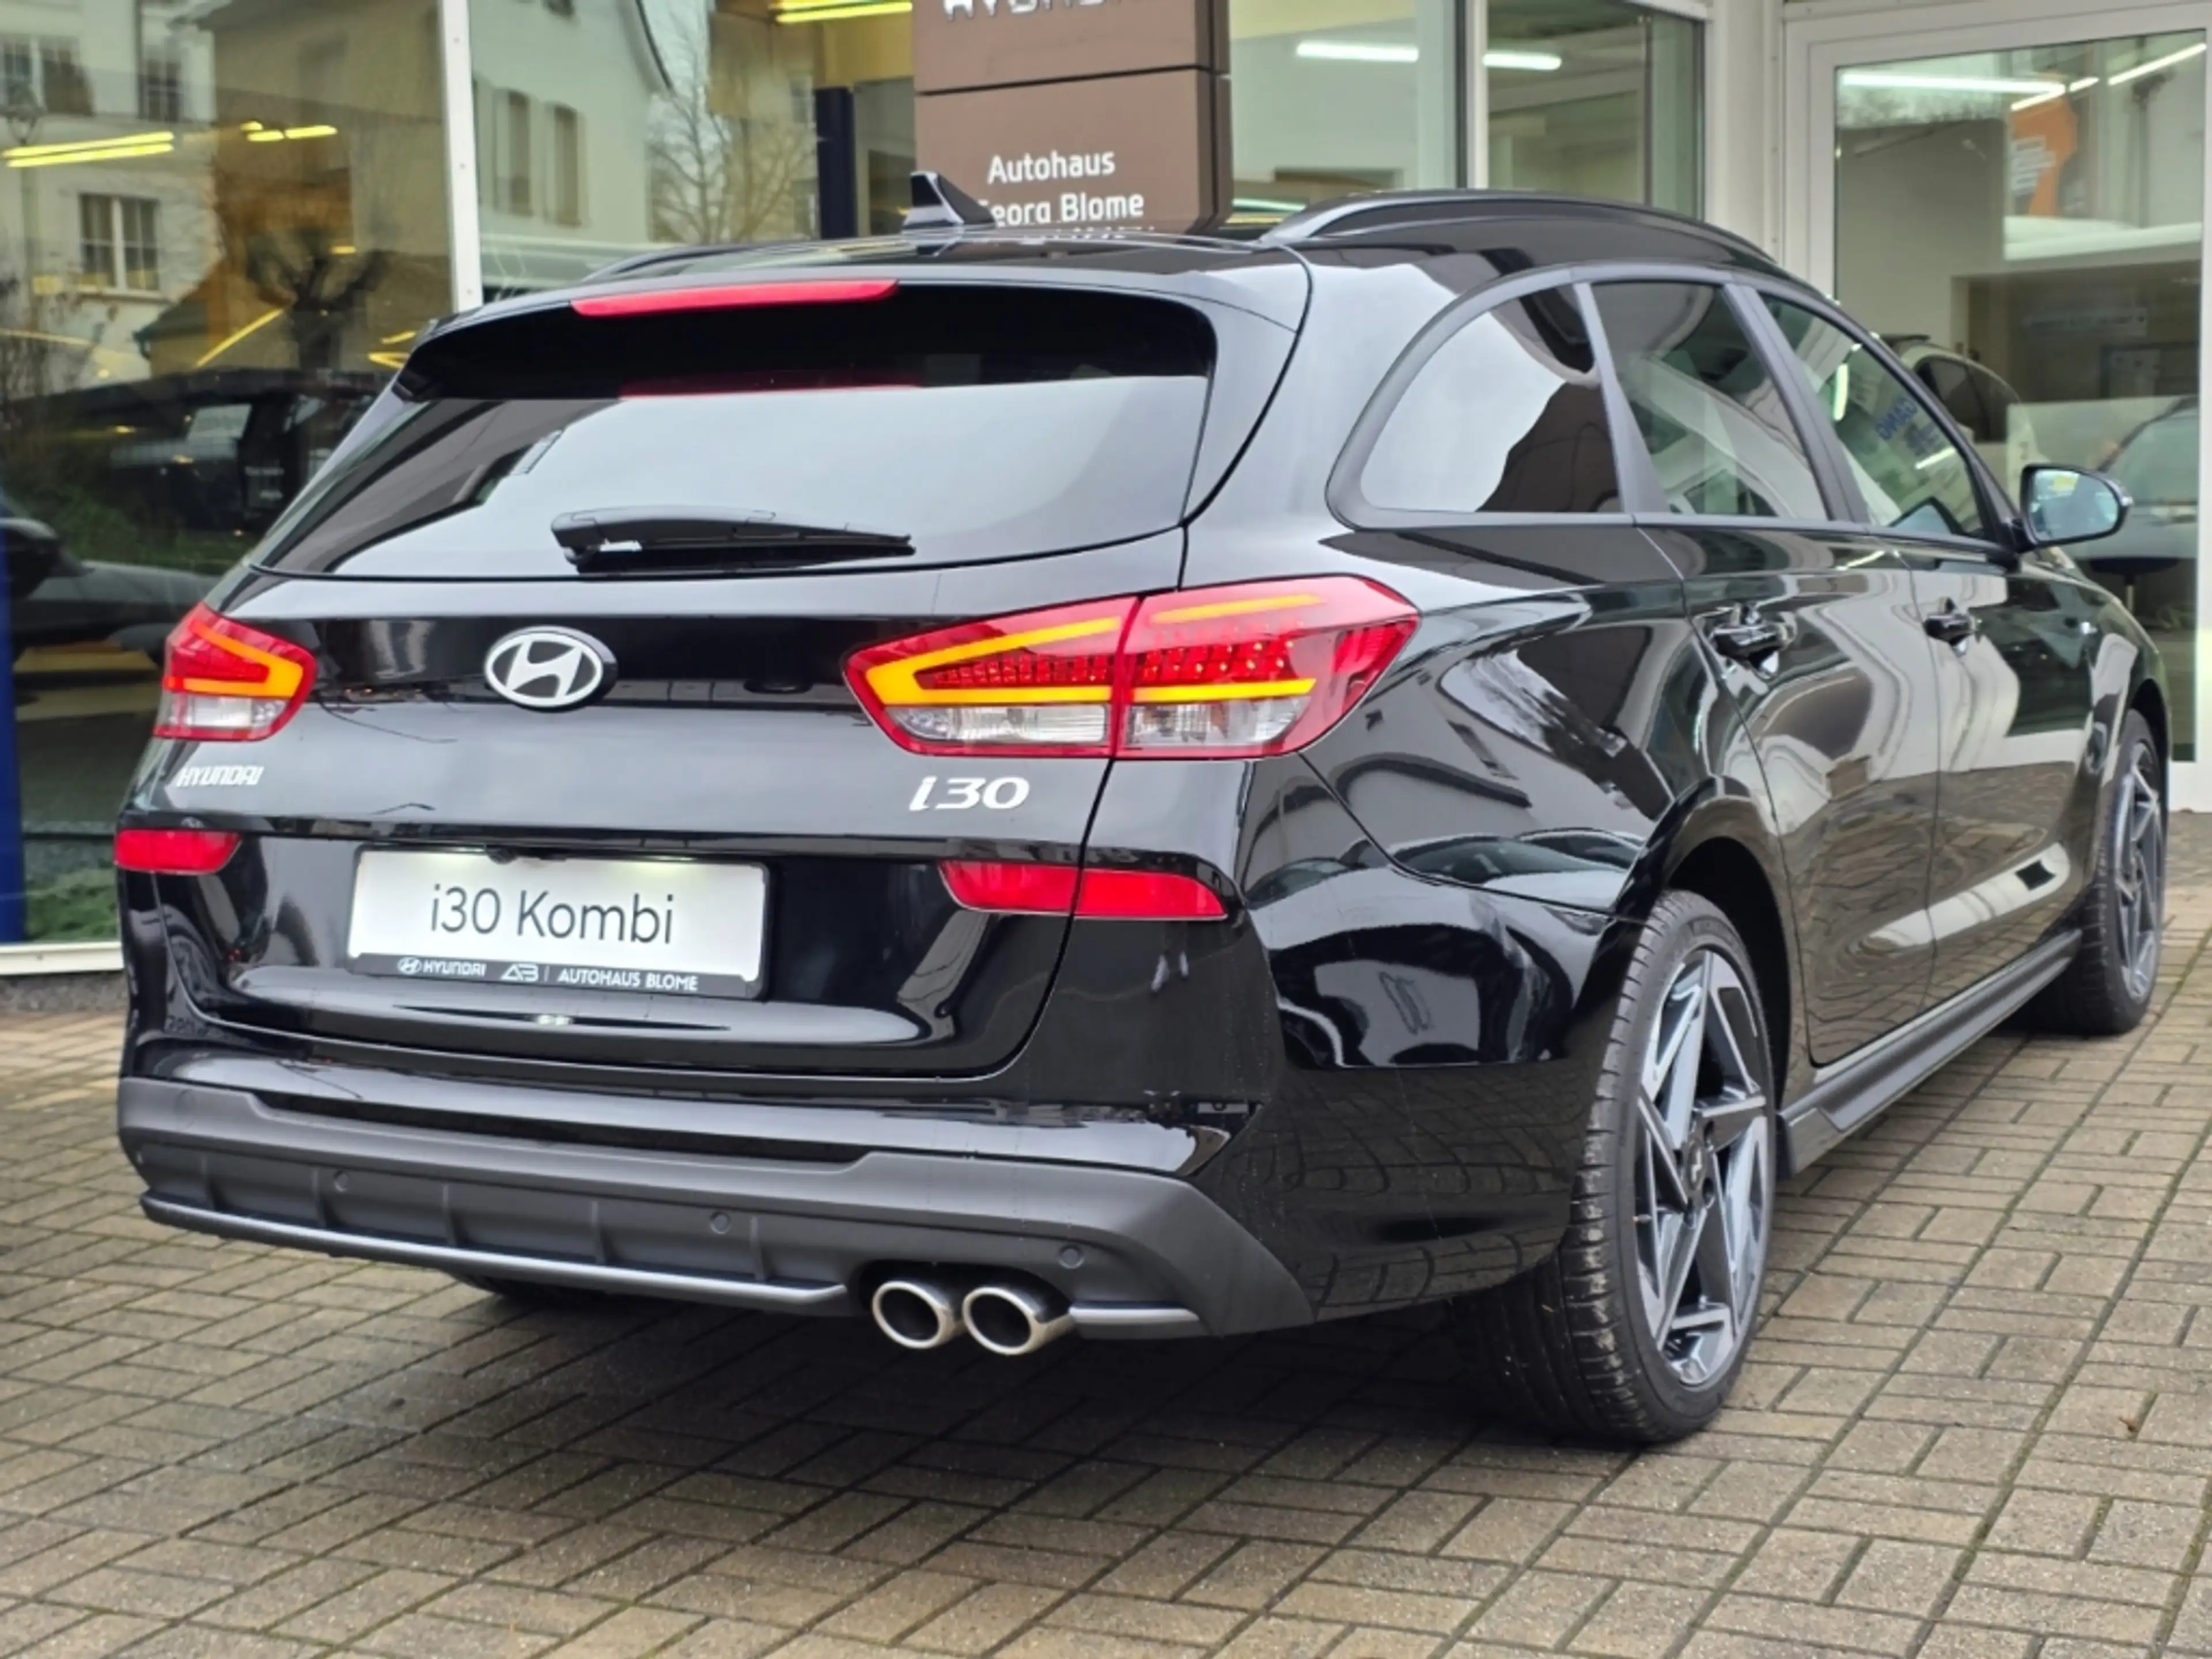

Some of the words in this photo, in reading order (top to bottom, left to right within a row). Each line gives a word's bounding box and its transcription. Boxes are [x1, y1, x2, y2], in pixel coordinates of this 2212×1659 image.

[987, 149, 1116, 184] Autohaus
[978, 199, 1051, 227] eorg
[1060, 192, 1144, 223] Blome
[176, 766, 264, 787] HYUNDAI
[909, 775, 1030, 811] i30
[431, 883, 501, 934] i30
[517, 889, 673, 944] Kombi
[423, 959, 487, 978] HYUNDAI
[557, 968, 641, 988] AUTOHAUS
[645, 973, 698, 992] BLOME
